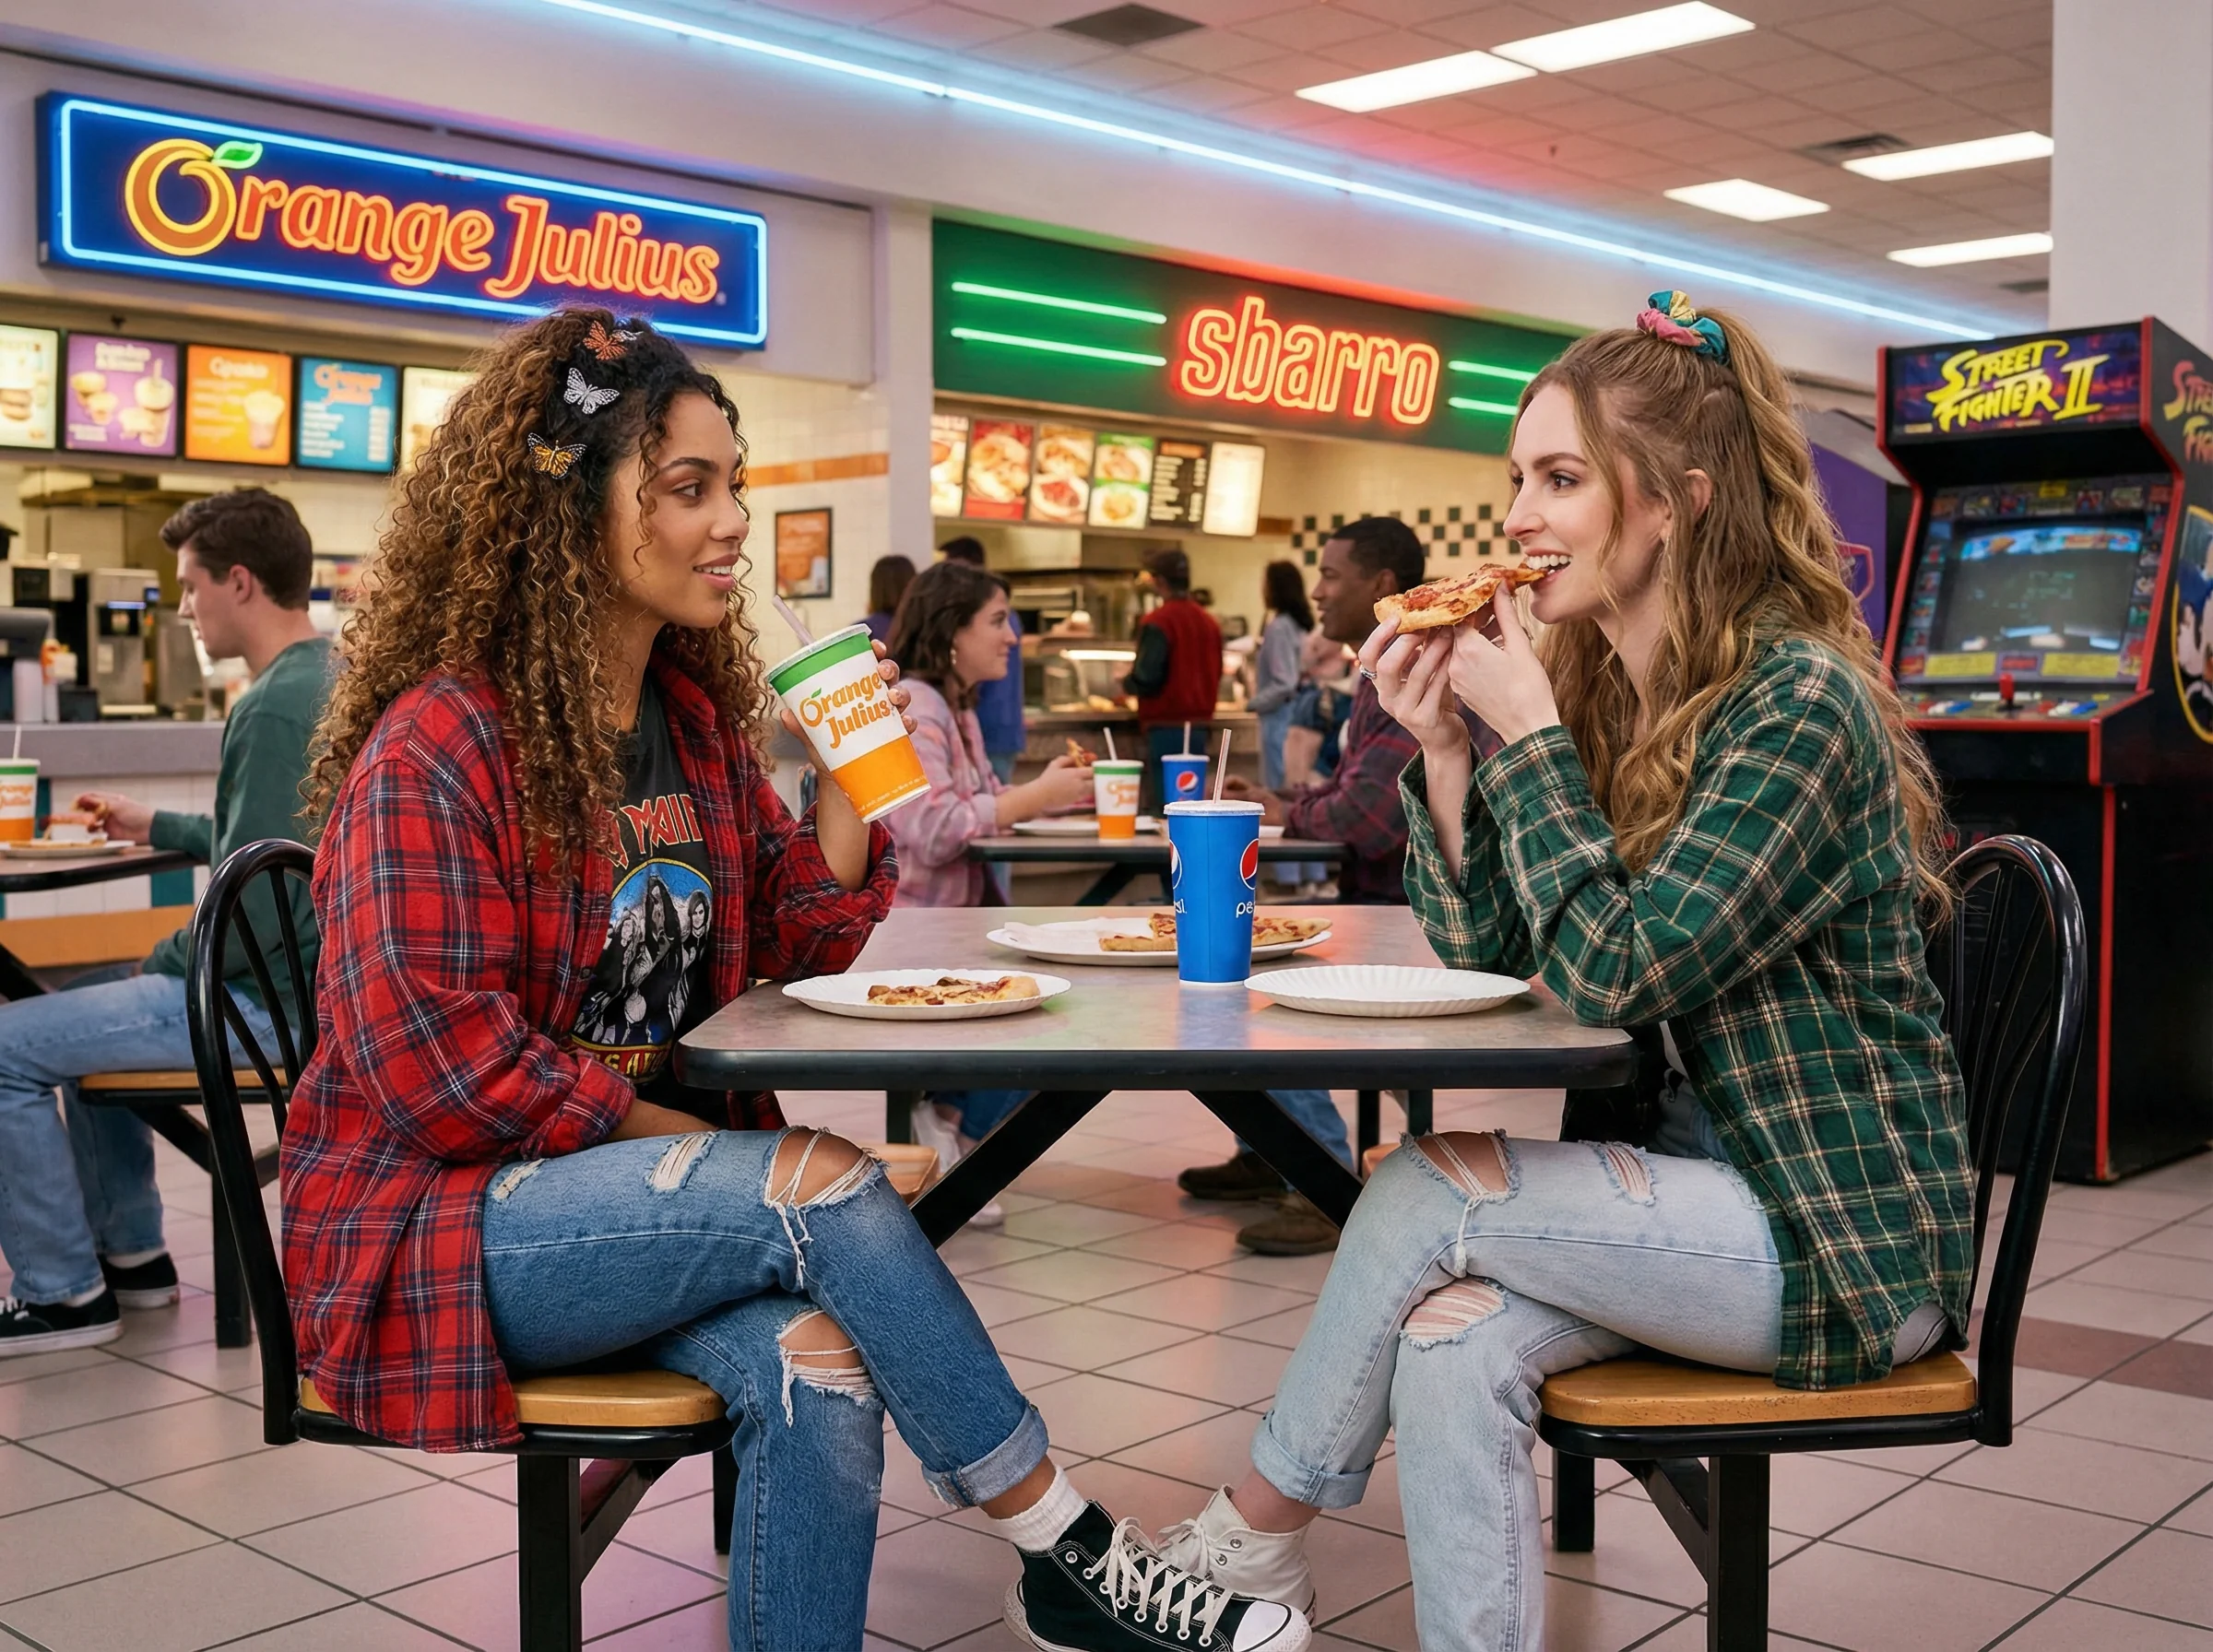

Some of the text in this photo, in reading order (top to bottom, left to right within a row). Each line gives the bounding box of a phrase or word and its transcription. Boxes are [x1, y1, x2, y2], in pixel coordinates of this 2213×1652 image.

[124, 138, 719, 303] Orange Julius
[1181, 295, 1440, 425] sbarro
[1925, 339, 2069, 403] STREET
[1933, 354, 2111, 433] FIGHTER II
[799, 672, 882, 727] Orange
[825, 700, 891, 749] Julius
